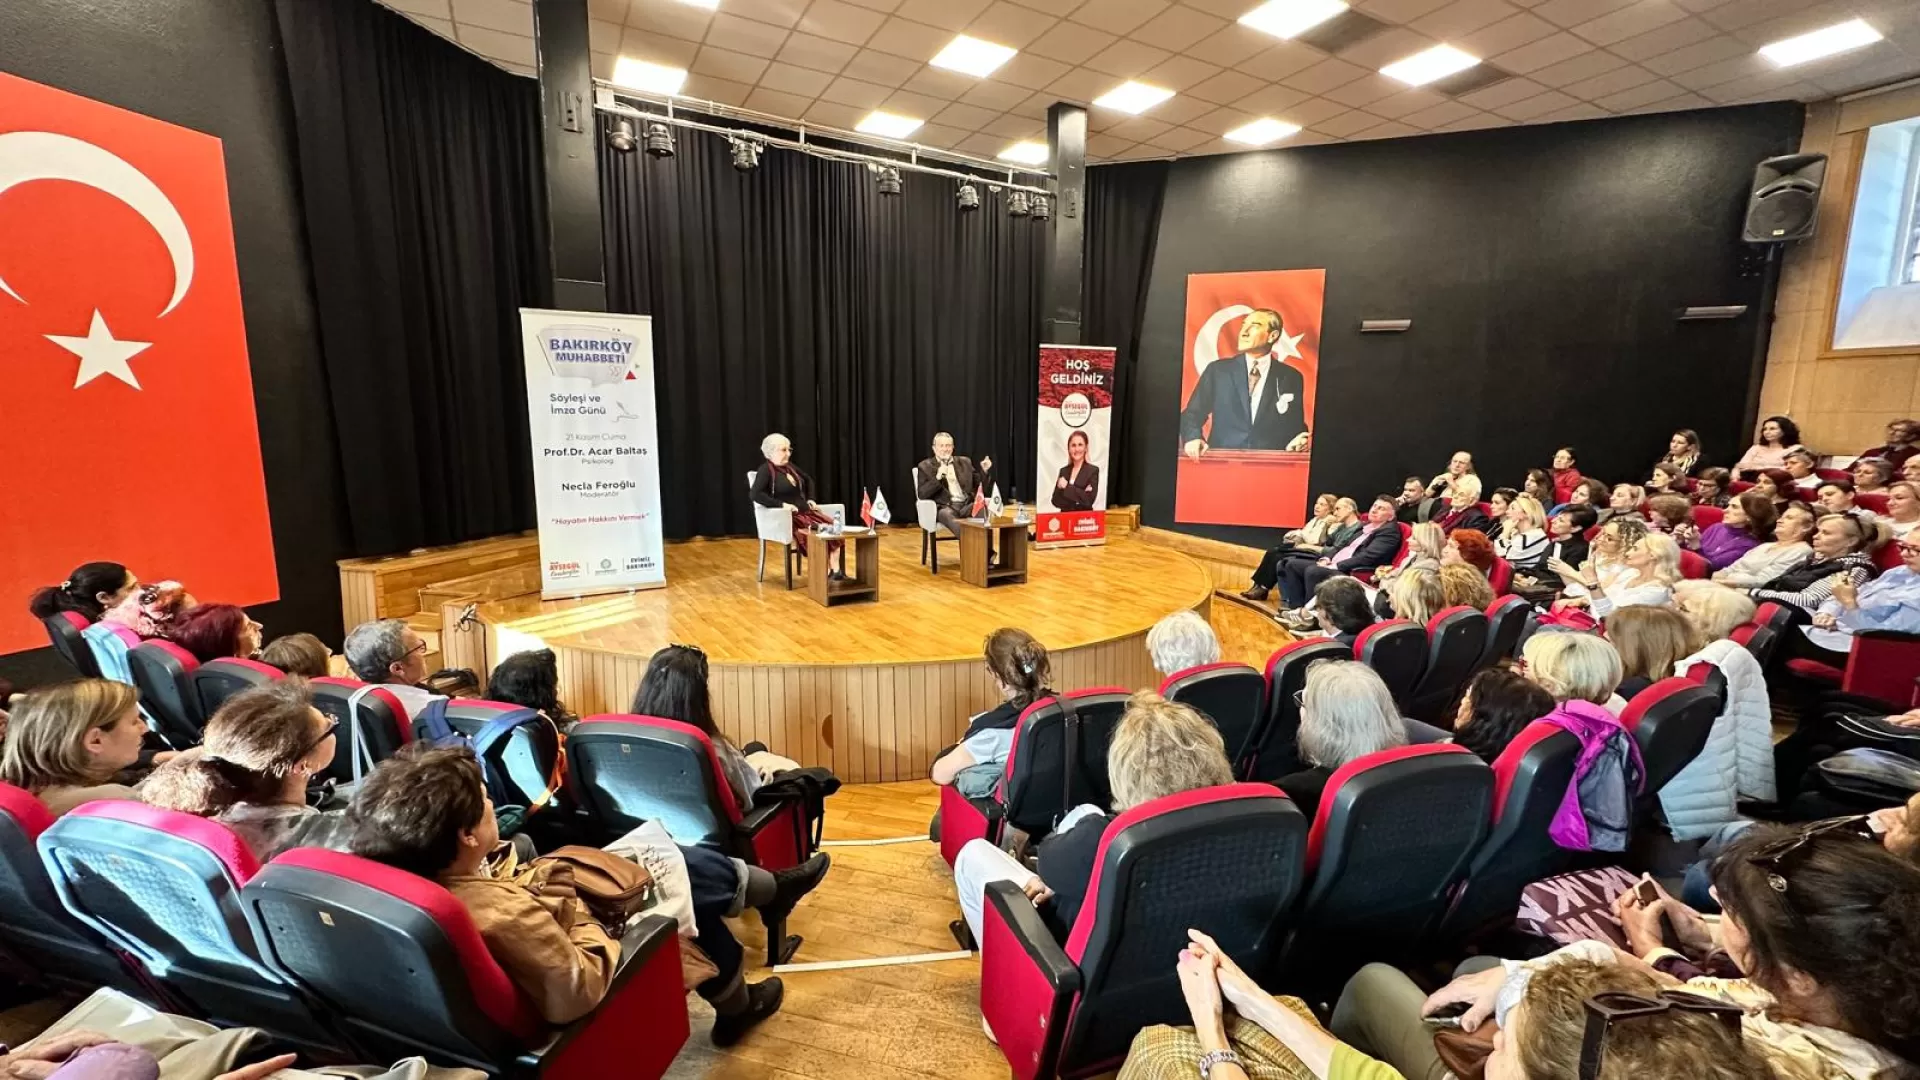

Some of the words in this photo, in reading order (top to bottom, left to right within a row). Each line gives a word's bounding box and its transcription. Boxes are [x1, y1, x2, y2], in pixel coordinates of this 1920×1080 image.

[550, 338, 632, 353] BAKIRKÖY
[556, 353, 626, 364] MUHABBETİ
[1066, 360, 1090, 372] HOŞ
[1050, 372, 1104, 385] GELDİNİZ
[550, 393, 587, 404] Söyleşi
[588, 395, 601, 403] ve
[550, 403, 576, 415] İmza
[578, 405, 606, 415] Günü
[601, 433, 627, 441] Cuma
[588, 447, 612, 456] Acar
[616, 447, 647, 456] Baltaş
[562, 482, 592, 491] Necla
[595, 480, 636, 491] Feroğlu
